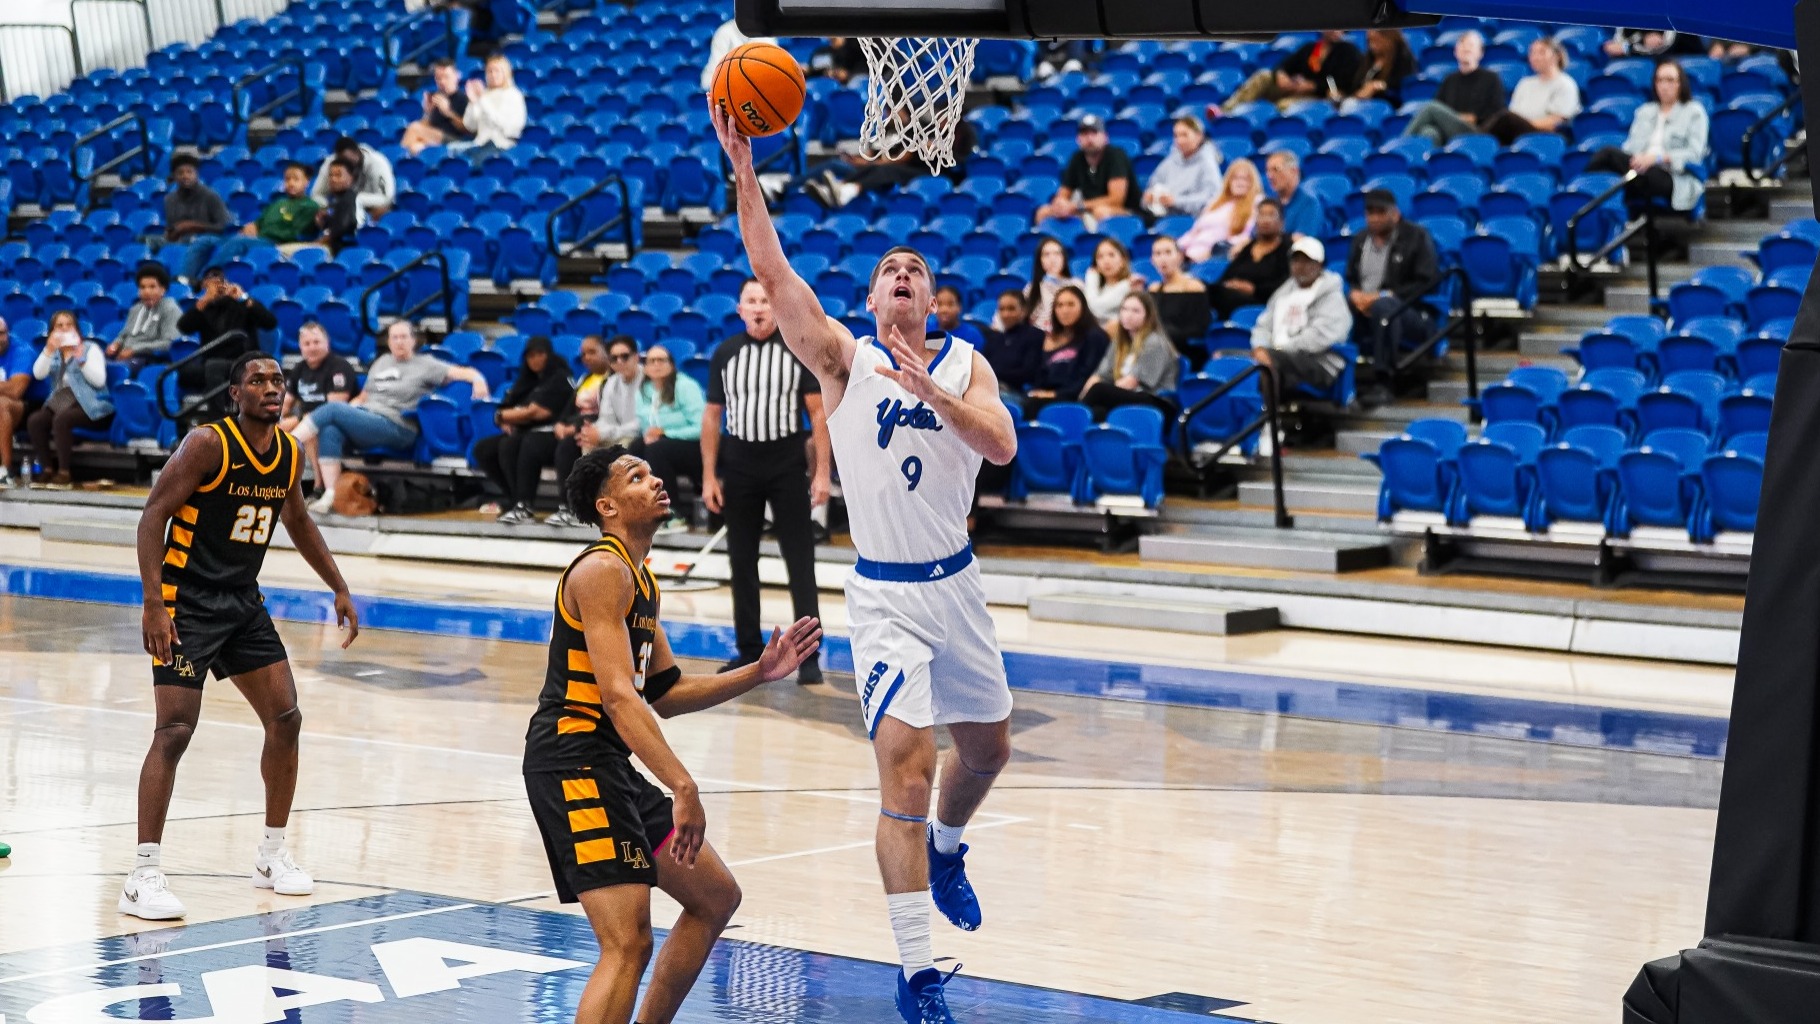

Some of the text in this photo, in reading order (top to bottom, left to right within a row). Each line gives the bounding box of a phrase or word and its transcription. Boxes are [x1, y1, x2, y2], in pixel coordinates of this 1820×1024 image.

[741, 101, 773, 133] NCAA
[901, 455, 923, 491] 9
[228, 482, 287, 501] Los Angeles
[229, 504, 273, 545] 23
[173, 654, 195, 677] LA
[620, 841, 650, 869] LA
[0, 936, 593, 1024] CAA
